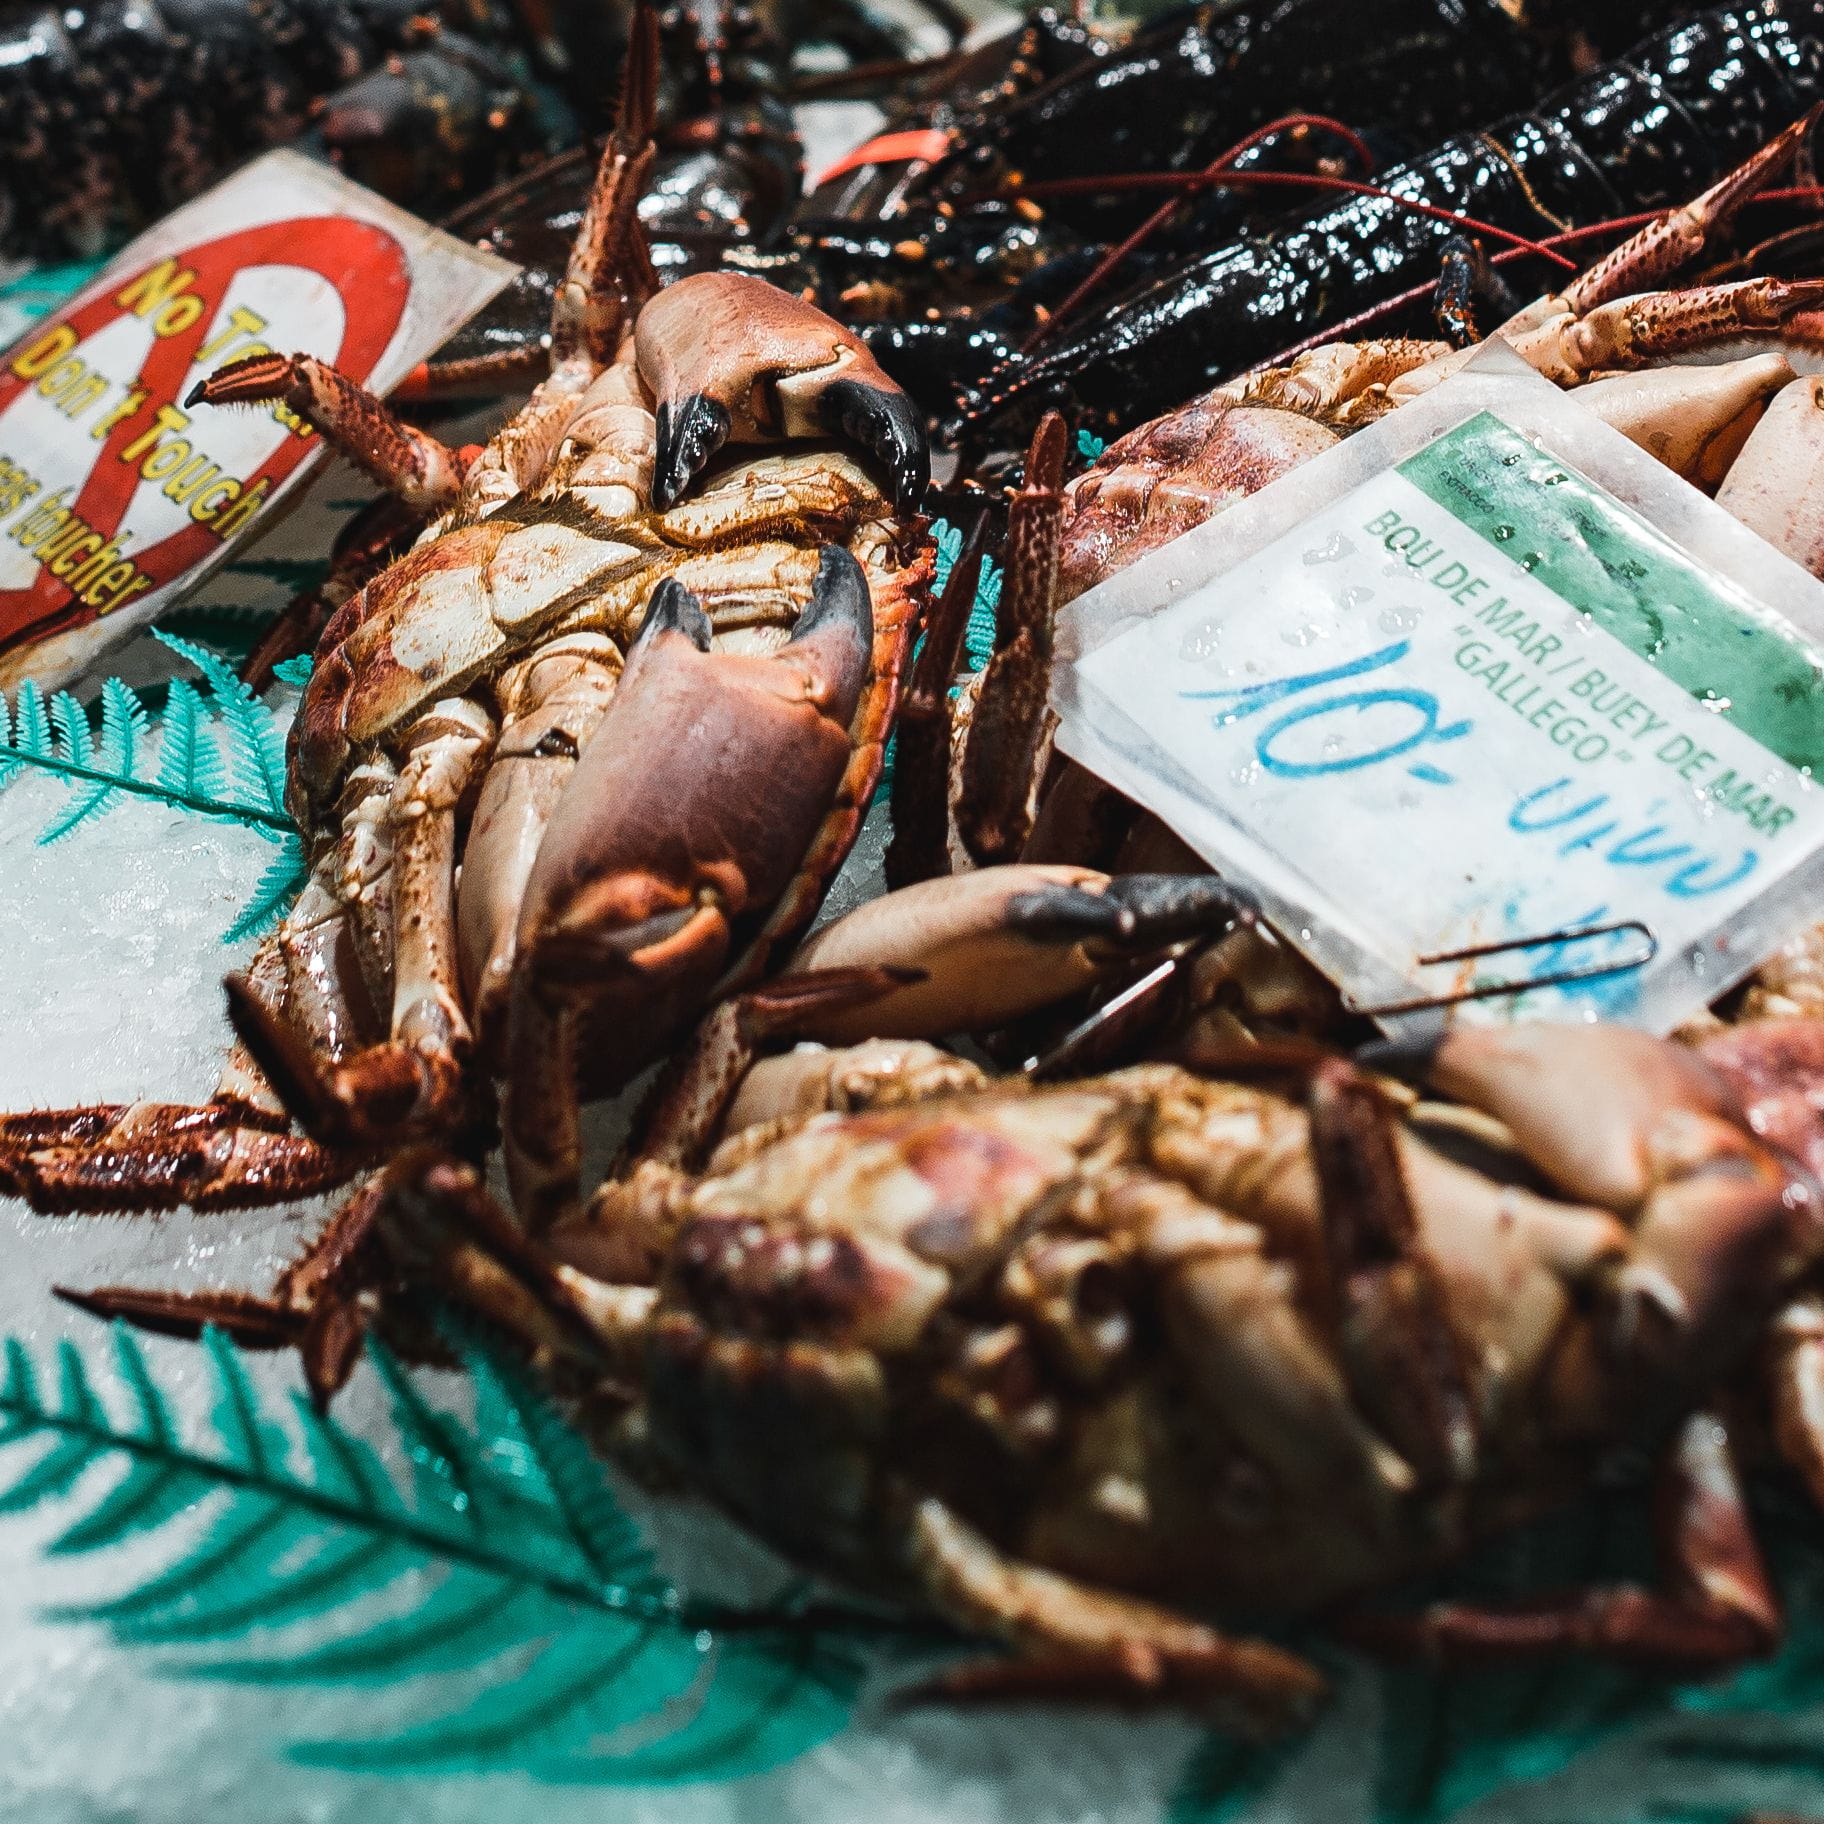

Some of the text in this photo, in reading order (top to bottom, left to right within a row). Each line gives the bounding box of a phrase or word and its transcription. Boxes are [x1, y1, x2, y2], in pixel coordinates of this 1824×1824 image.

[112, 256, 205, 339] No
[119, 404, 273, 540] Touch
[7, 486, 154, 619] toucher
[1362, 509, 1445, 570] BOU
[1431, 560, 1490, 607] DE
[1475, 596, 1564, 668] MAR
[1569, 667, 1670, 742] BUEY
[1656, 732, 1720, 783] DE
[1706, 768, 1798, 839] MAR
